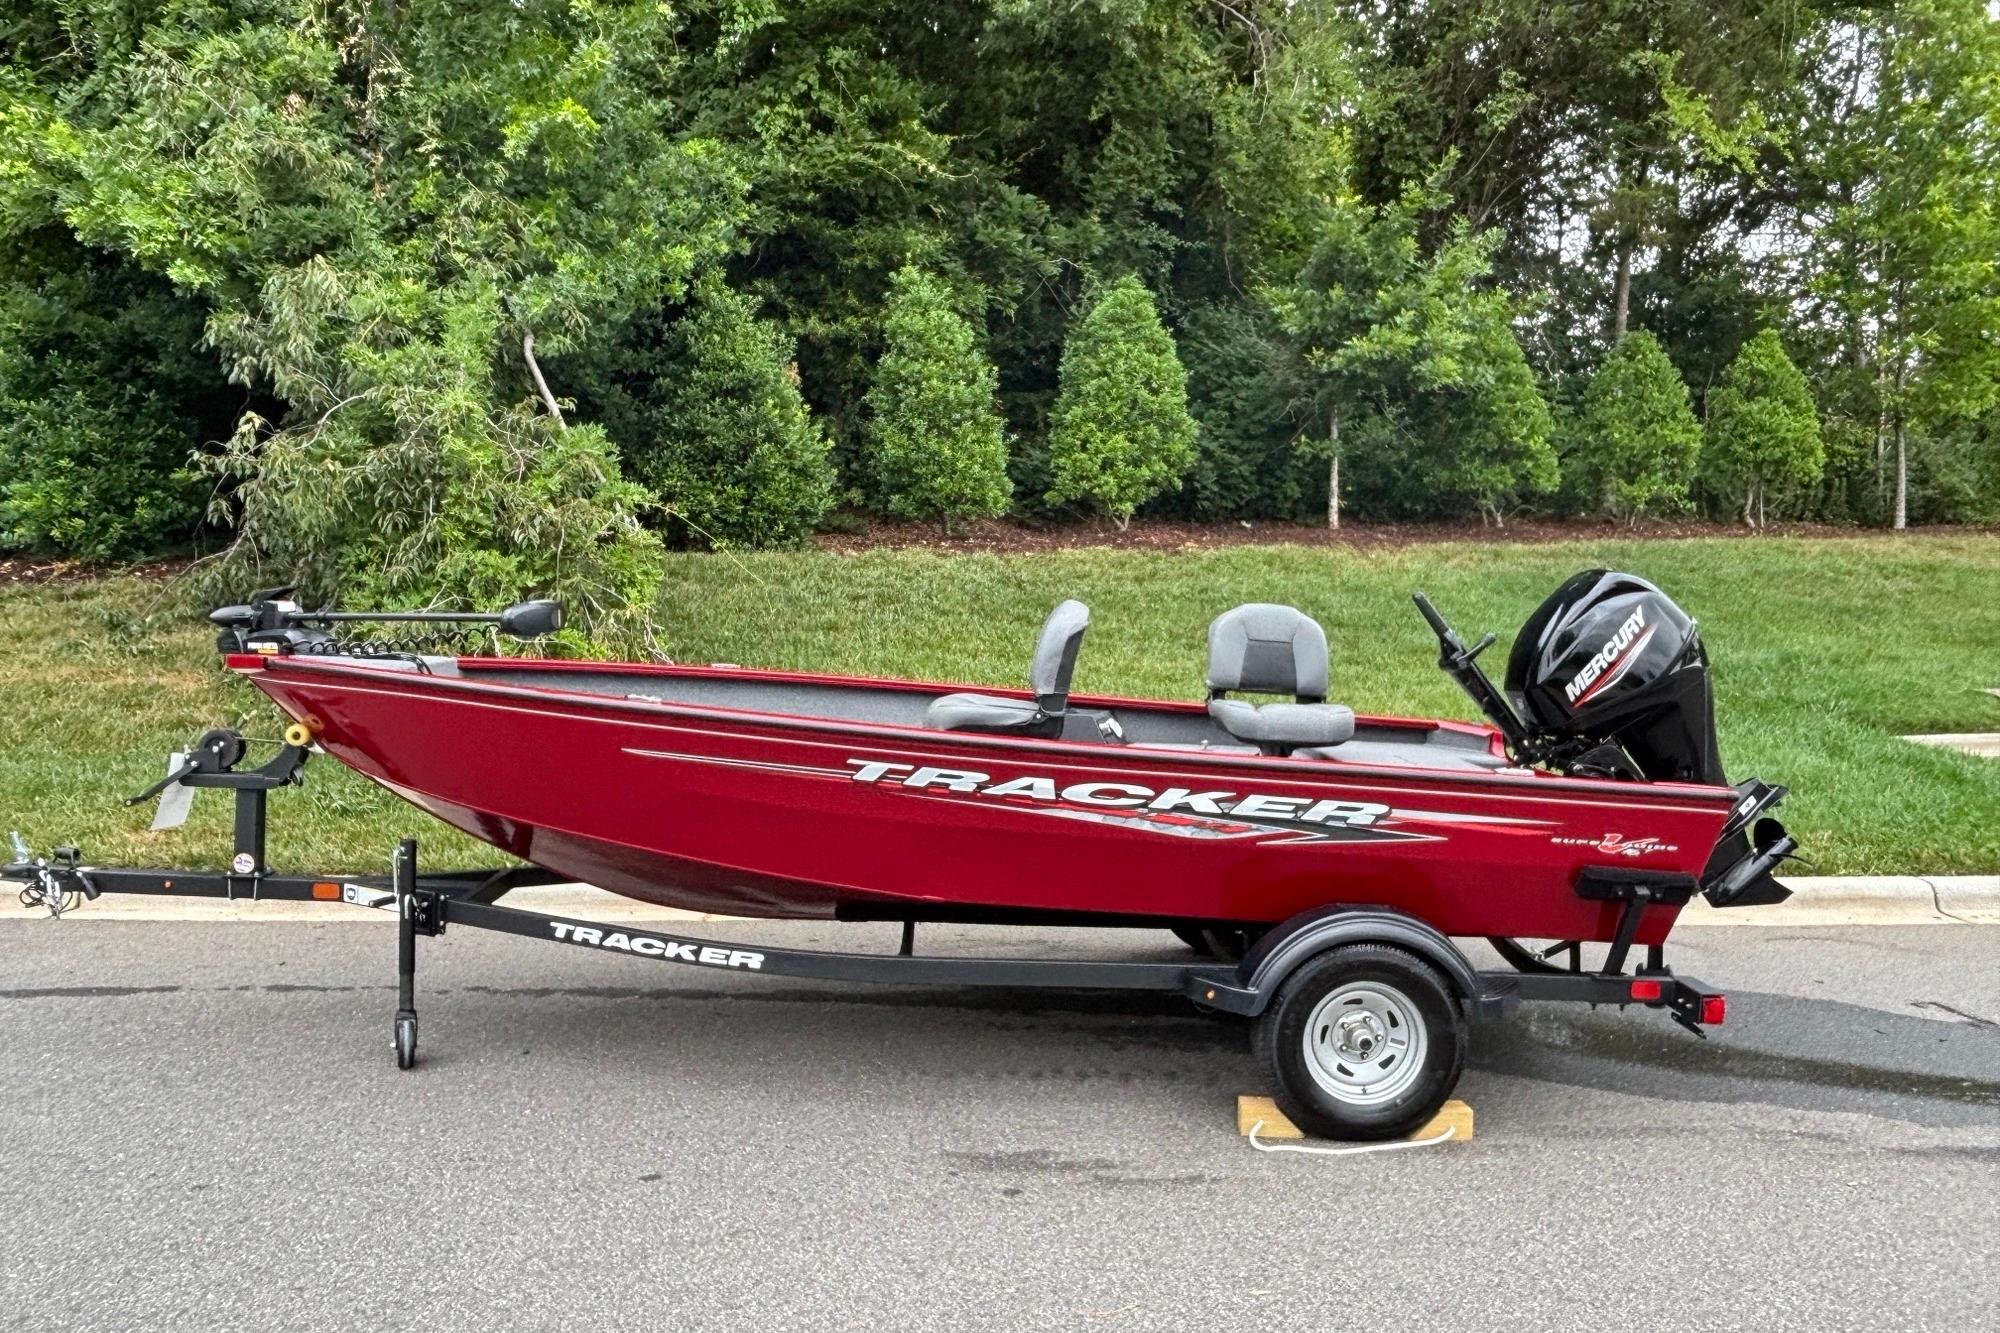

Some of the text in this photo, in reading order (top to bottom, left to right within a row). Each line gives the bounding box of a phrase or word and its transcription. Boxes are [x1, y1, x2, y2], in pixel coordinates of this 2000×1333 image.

[1565, 605, 1645, 702] MERCURY
[847, 759, 1391, 825] TRACKER
[550, 922, 765, 969] TRACKER
